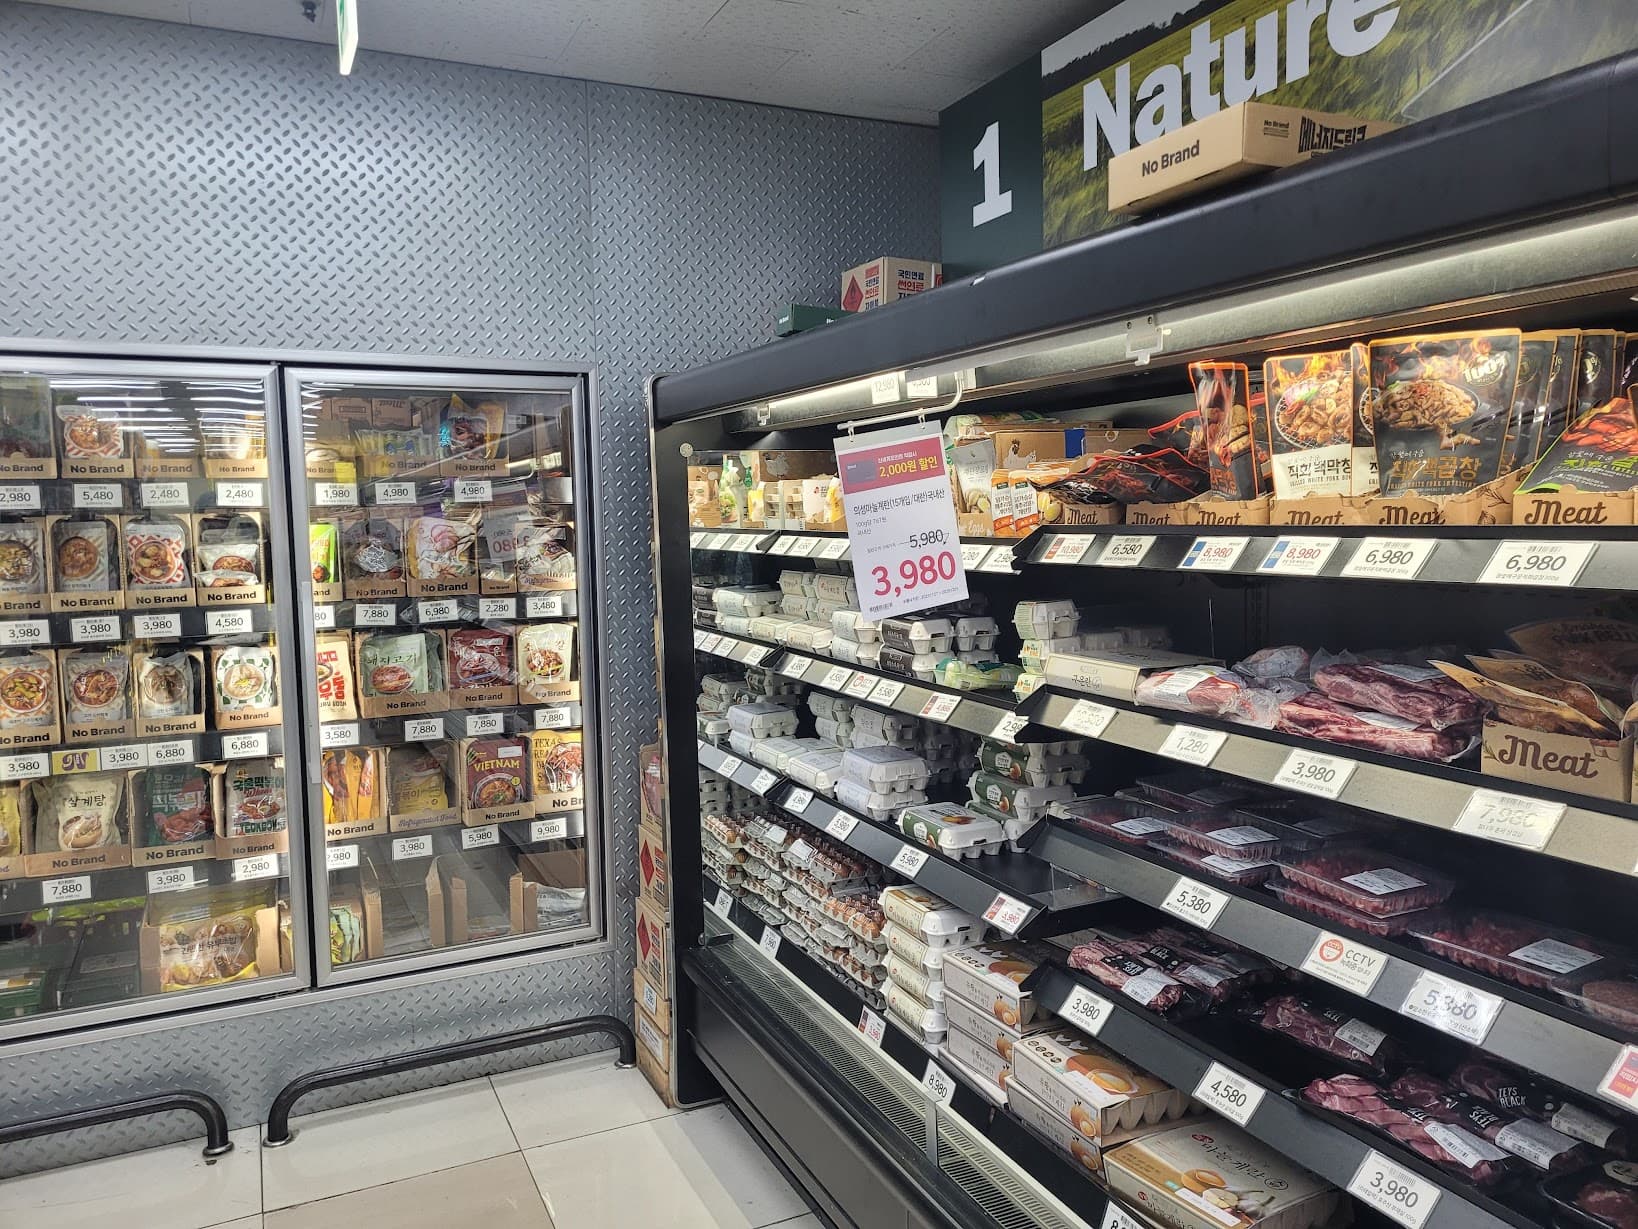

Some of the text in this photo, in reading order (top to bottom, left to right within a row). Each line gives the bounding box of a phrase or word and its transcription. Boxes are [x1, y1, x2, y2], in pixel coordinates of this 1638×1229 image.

[1082, 0, 1401, 172] Nature
[1264, 120, 1290, 129] No Brand
[1141, 141, 1200, 177] No Brand
[972, 120, 1013, 228] 1
[13, 463, 44, 472] Brand
[71, 464, 124, 473] No Brand
[143, 464, 192, 473] No Brand
[382, 460, 427, 469] No Brand
[879, 456, 938, 478] 2,000원 할인
[83, 491, 113, 501] 5,480
[150, 489, 180, 499] 2,480
[225, 489, 254, 499] 2,480
[324, 489, 350, 498] 1,980
[384, 488, 408, 497] 4,980
[461, 486, 485, 496] 4,980
[1067, 509, 1098, 525] Meat
[1379, 506, 1446, 525] Meat
[1524, 499, 1608, 525] Meat
[1197, 510, 1241, 525] Meat
[1288, 510, 1343, 525] Meat
[909, 529, 944, 549] 5,980
[1112, 544, 1142, 555] 6,580
[1203, 548, 1232, 558] 8,980
[1286, 548, 1321, 559] 8,980
[1365, 550, 1413, 565] 6,980
[1506, 555, 1566, 572] 6,980
[872, 551, 956, 597] 3,980
[356, 587, 397, 596] No Brand
[421, 582, 468, 592] No Brand
[136, 595, 187, 605] No Brand
[208, 591, 256, 601] No Brand
[4, 601, 41, 610] Brand
[60, 597, 114, 607] No Brand
[532, 601, 556, 609] 3,480
[425, 606, 450, 616] 6,980
[485, 604, 509, 613] 2,280
[363, 609, 389, 619] 7,880
[143, 620, 172, 630] 3,980
[215, 617, 243, 627] 4,580
[8, 628, 40, 638] 3,980
[81, 624, 111, 635] 3,980
[549, 689, 571, 697] Brand
[386, 700, 426, 710] No Brand
[542, 713, 564, 723] 7,880
[146, 721, 196, 733] No Brand
[473, 719, 496, 729] 7,880
[72, 726, 125, 737] No Brand
[325, 729, 351, 740] 3,580
[412, 725, 436, 735] 7,880
[14, 733, 50, 744] Brand
[231, 739, 259, 750] 6,880
[1176, 736, 1209, 754] 1,280
[109, 752, 139, 763] 3,980
[156, 748, 185, 758] 6,880
[1498, 734, 1598, 779] Meat
[8, 761, 40, 772] 3,980
[474, 759, 520, 770] VIETNAM
[1293, 761, 1336, 783] 3,980
[552, 799, 567, 808] No
[486, 810, 520, 820] No Brand
[327, 823, 374, 836] No Brand
[537, 824, 560, 834] 9,980
[469, 832, 492, 842] 5,980
[247, 843, 274, 852] Brand
[401, 842, 424, 851] 3,980
[146, 845, 204, 860] No Brand
[52, 855, 106, 868] No Brand
[899, 853, 919, 867] 5,980
[241, 862, 269, 872] 2,980
[156, 873, 186, 884] 3,980
[51, 884, 82, 895] 7,880
[1176, 890, 1211, 915] 5,380
[1345, 949, 1377, 968] CCTV
[1072, 999, 1101, 1020] 3,980
[928, 1075, 948, 1098] 8,980
[1211, 1081, 1246, 1107] 4,580
[1498, 1087, 1517, 1097] TEYS
[1370, 1172, 1418, 1208] 3,980
